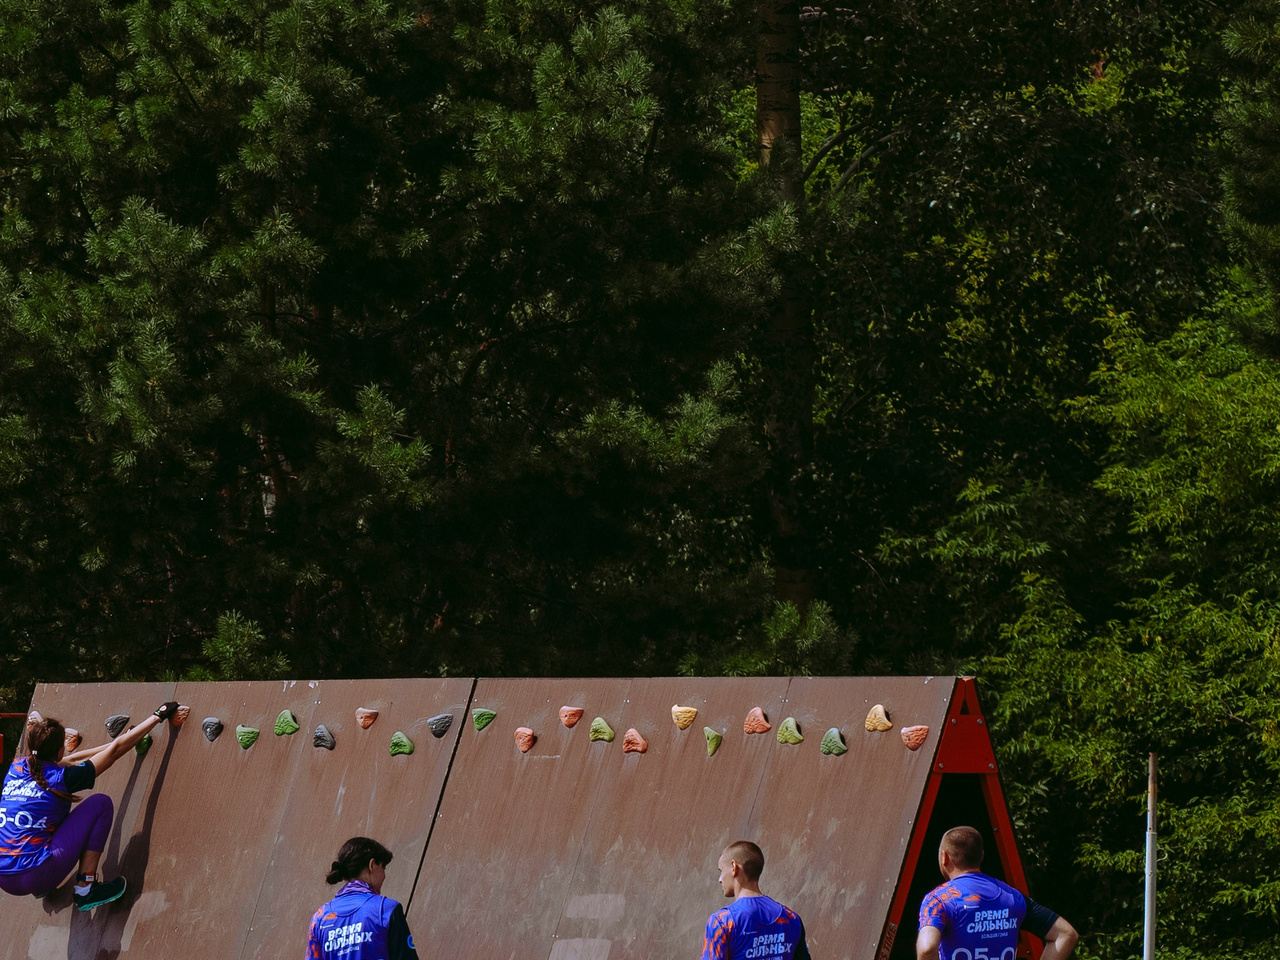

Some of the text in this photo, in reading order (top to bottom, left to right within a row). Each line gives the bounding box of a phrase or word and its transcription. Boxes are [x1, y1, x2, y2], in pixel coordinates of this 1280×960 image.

[974, 908, 1009, 922] ВРЕМЯ
[328, 922, 362, 941] ВРЕМЯ
[966, 917, 1017, 933] СИЛЬНЫХ
[324, 932, 373, 952] СИЛЬНЫХ
[753, 932, 785, 947] ВРЕМЯ
